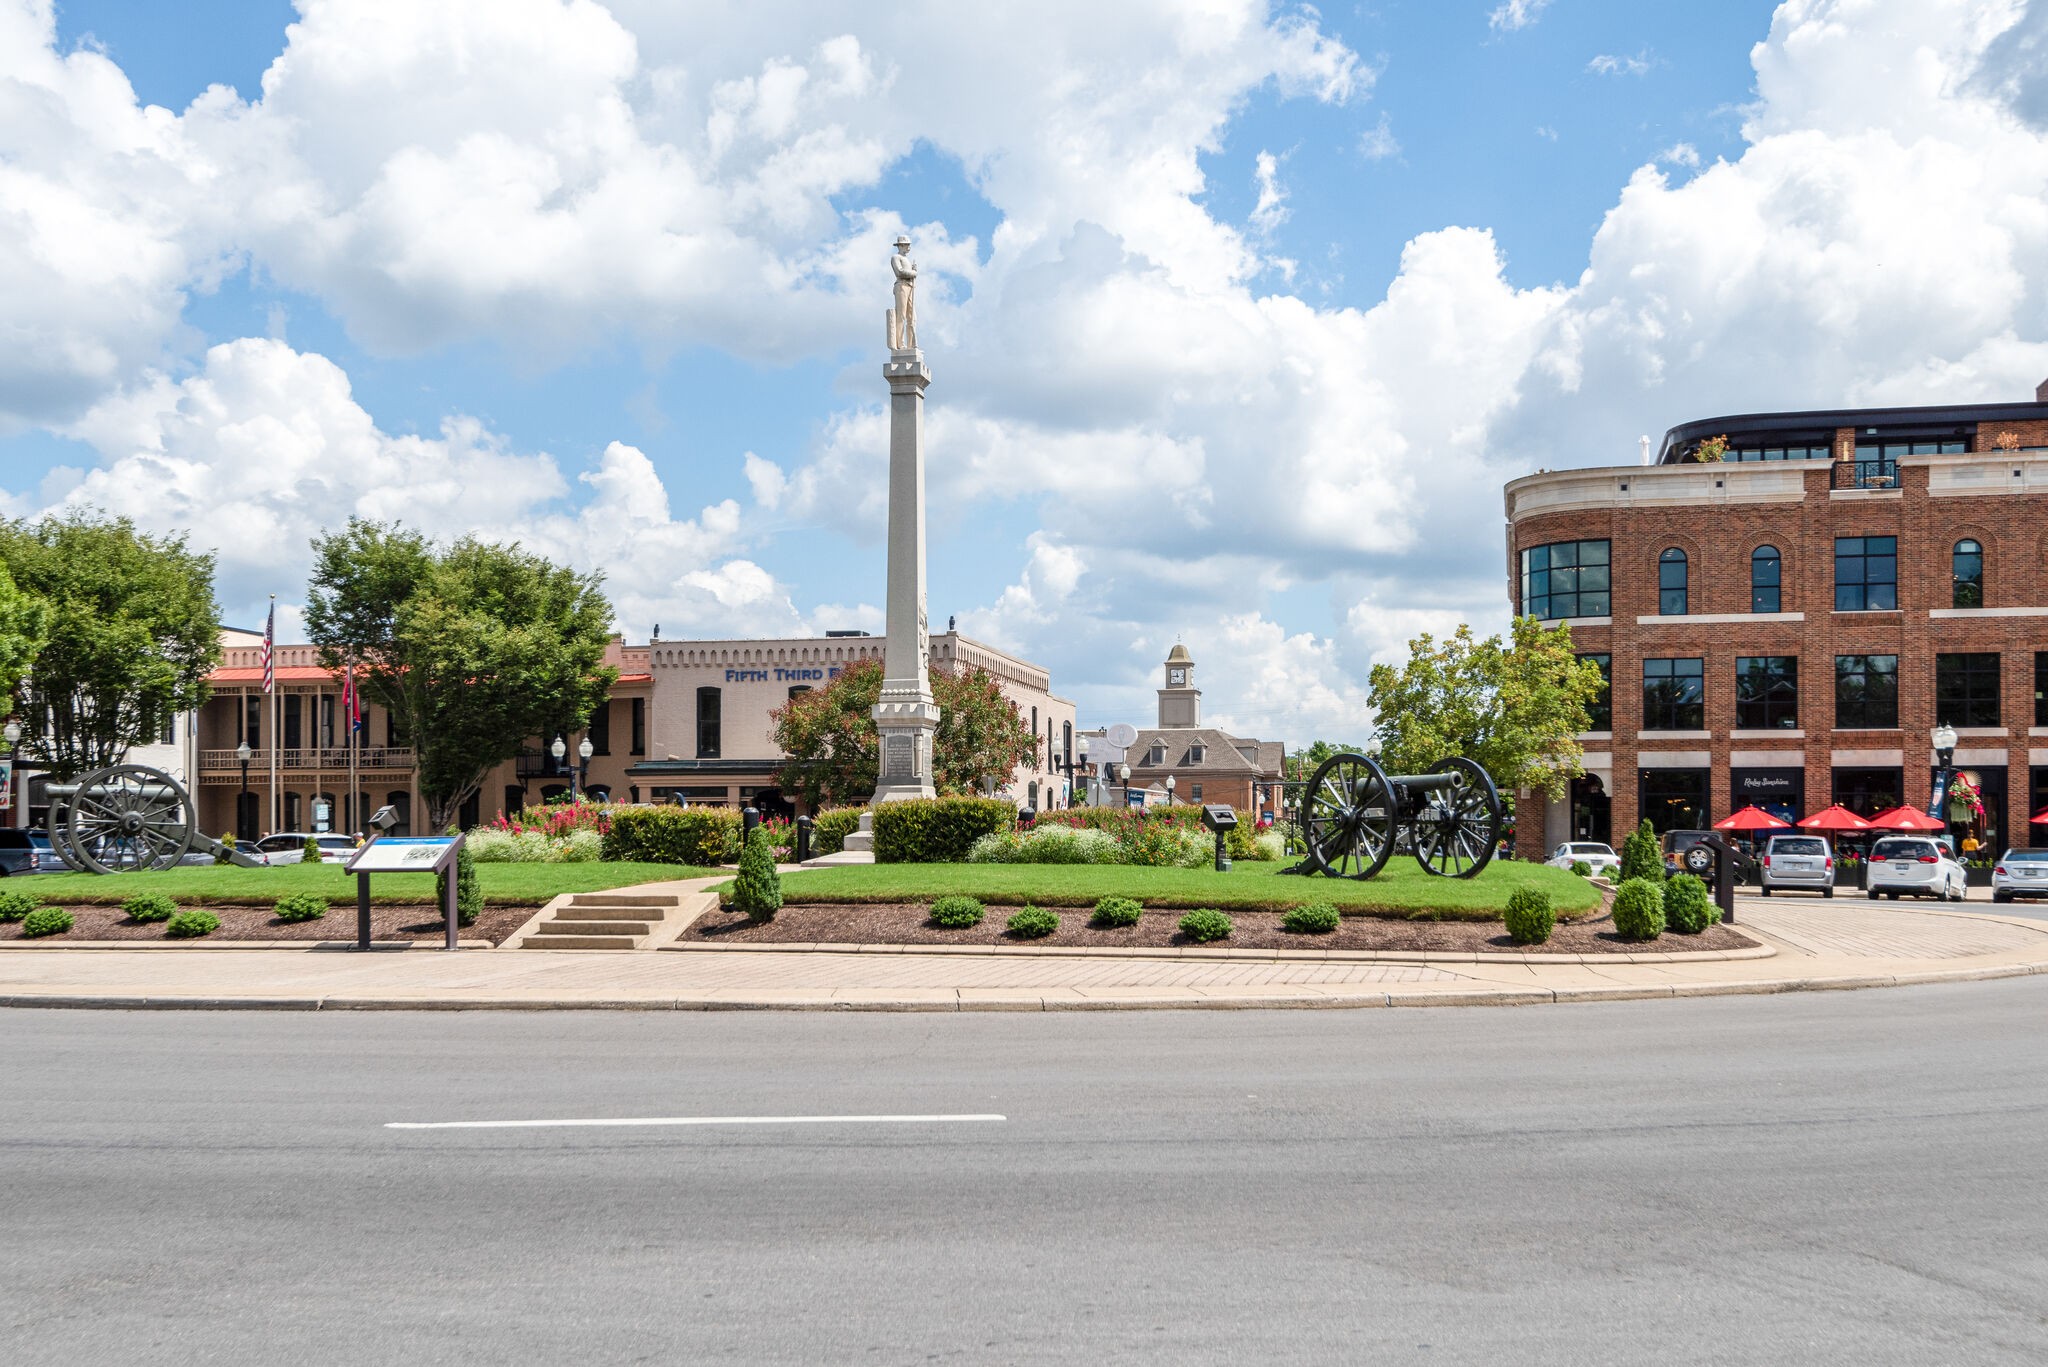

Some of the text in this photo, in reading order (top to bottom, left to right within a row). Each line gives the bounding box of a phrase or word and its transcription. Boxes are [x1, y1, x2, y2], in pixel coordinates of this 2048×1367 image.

[725, 669, 768, 682] FIFTH
[774, 668, 823, 681] THIRD
[1744, 777, 1789, 788] Ruby Sunshine
